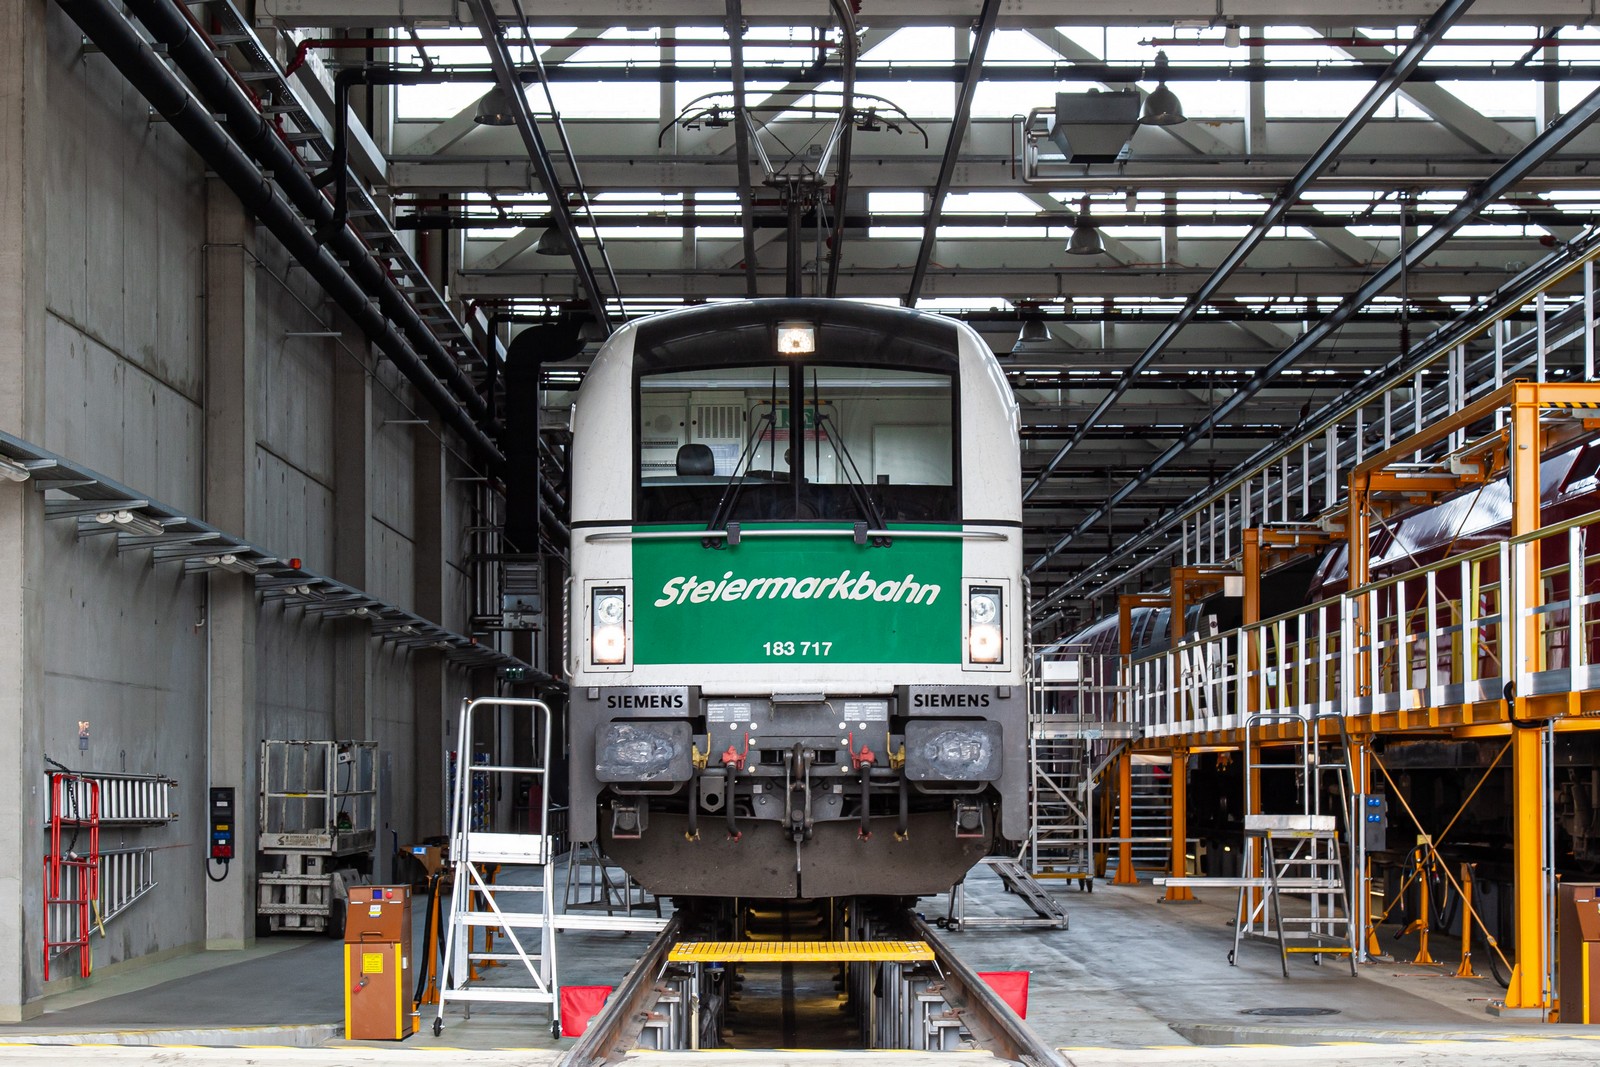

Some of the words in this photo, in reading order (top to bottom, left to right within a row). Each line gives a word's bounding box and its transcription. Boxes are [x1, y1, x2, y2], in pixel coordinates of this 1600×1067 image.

[654, 570, 941, 607] Steiermarkbahn
[763, 641, 795, 656] 183
[800, 641, 833, 656] 717
[607, 695, 684, 709] SIEMENS
[913, 693, 990, 708] SIEMENS
